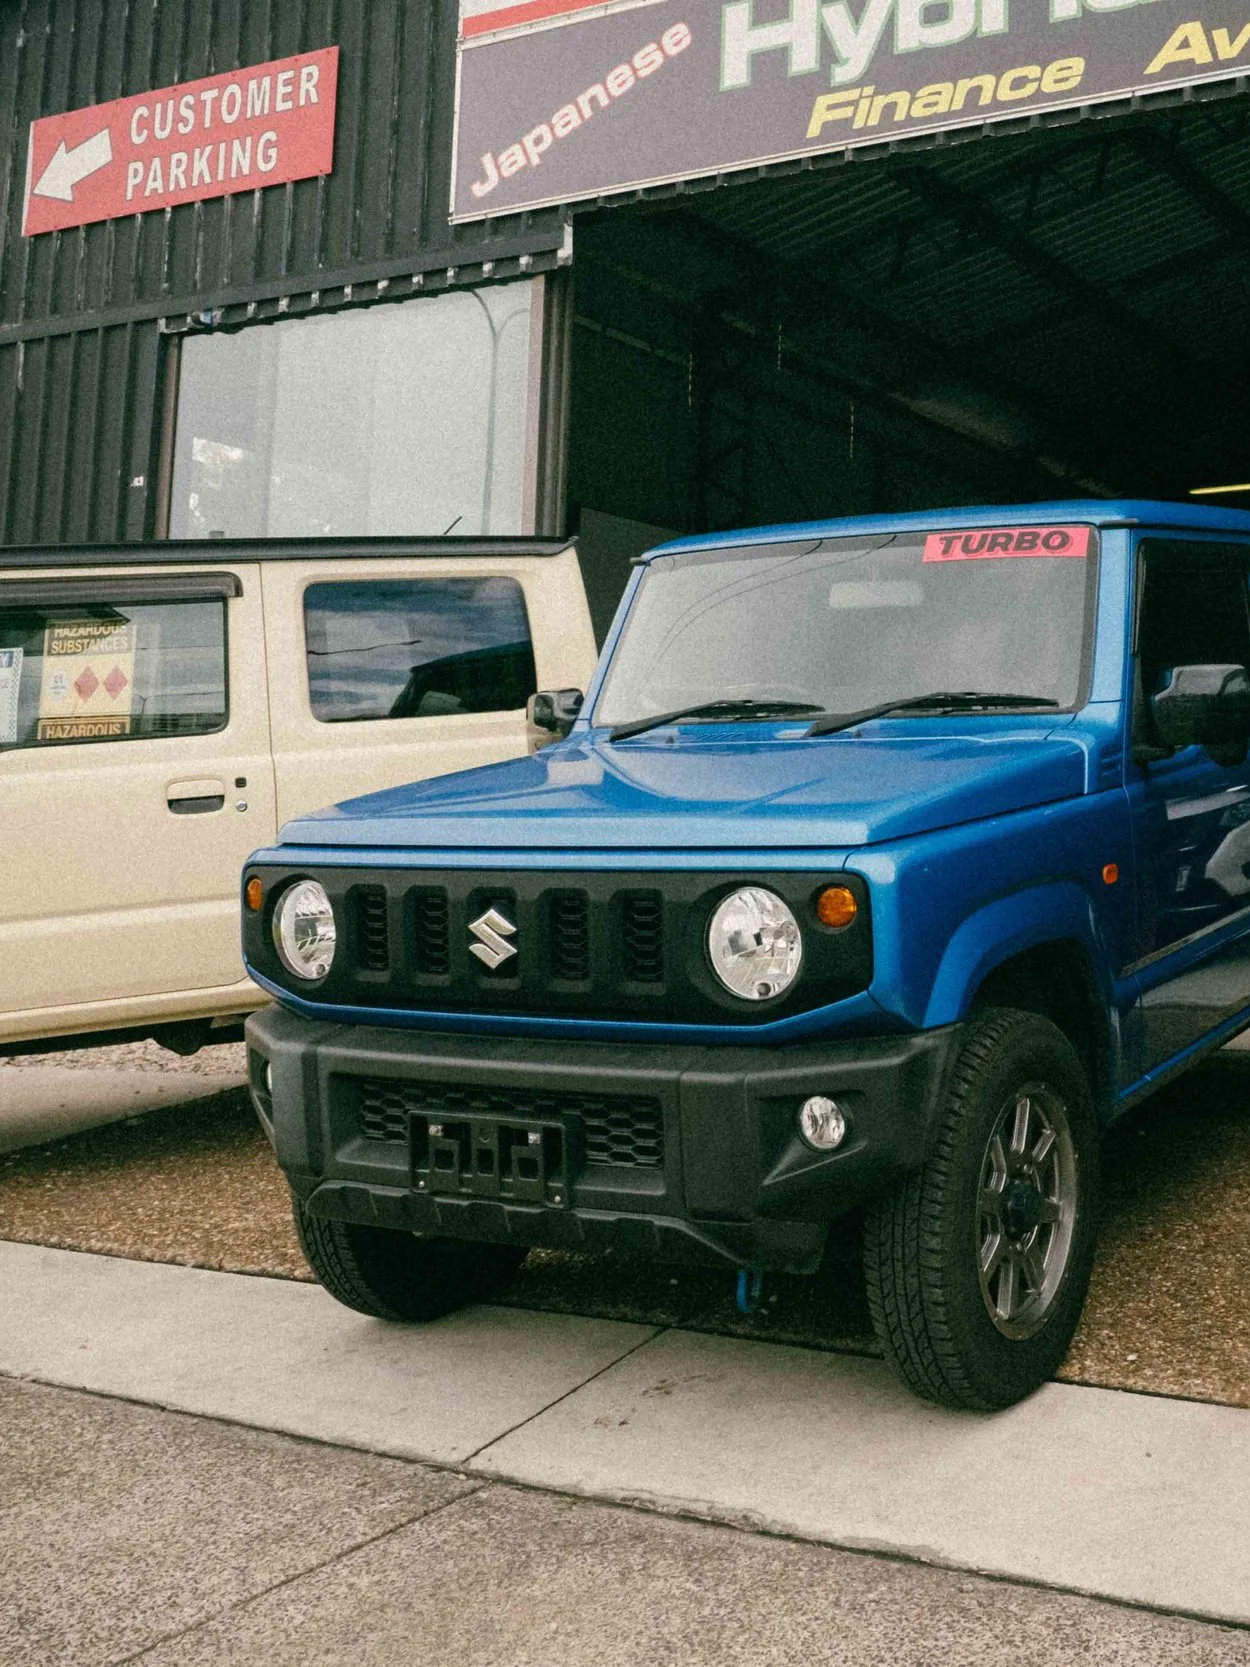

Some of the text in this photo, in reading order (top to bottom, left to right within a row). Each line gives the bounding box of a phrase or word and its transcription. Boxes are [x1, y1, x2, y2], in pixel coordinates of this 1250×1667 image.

[129, 64, 321, 146] CUSTOMER
[470, 21, 693, 198] Japanese
[806, 56, 1086, 139] Finance
[125, 130, 279, 201] PARKING
[939, 530, 1072, 556] TURBO
[51, 637, 128, 654] SUBSTANCES
